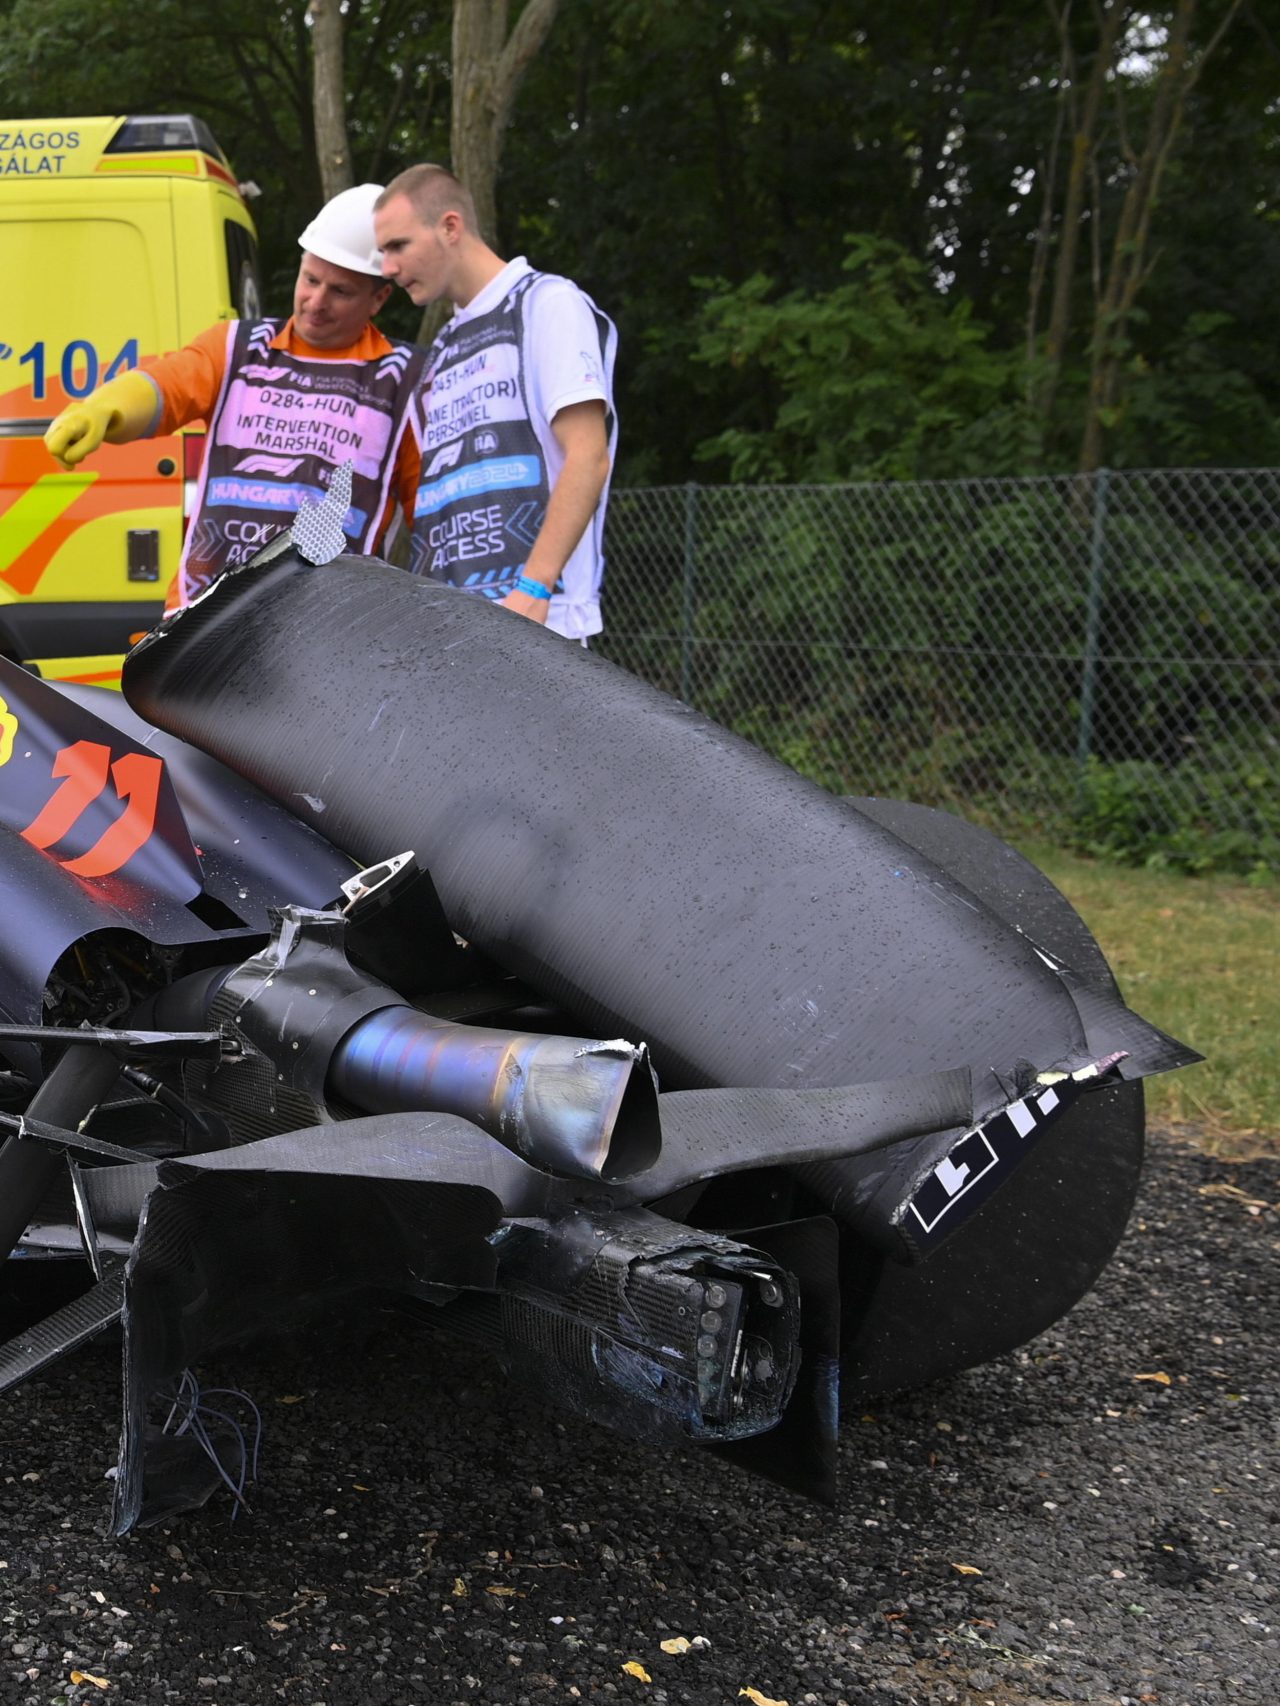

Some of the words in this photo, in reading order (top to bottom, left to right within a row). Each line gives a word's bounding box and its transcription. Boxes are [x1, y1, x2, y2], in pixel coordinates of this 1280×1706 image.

[19, 338, 138, 399] 104
[260, 389, 358, 418] 0284-HUN
[236, 413, 363, 449] INTERVENTION
[254, 431, 337, 460] MARSHAL
[20, 739, 163, 878] 11
